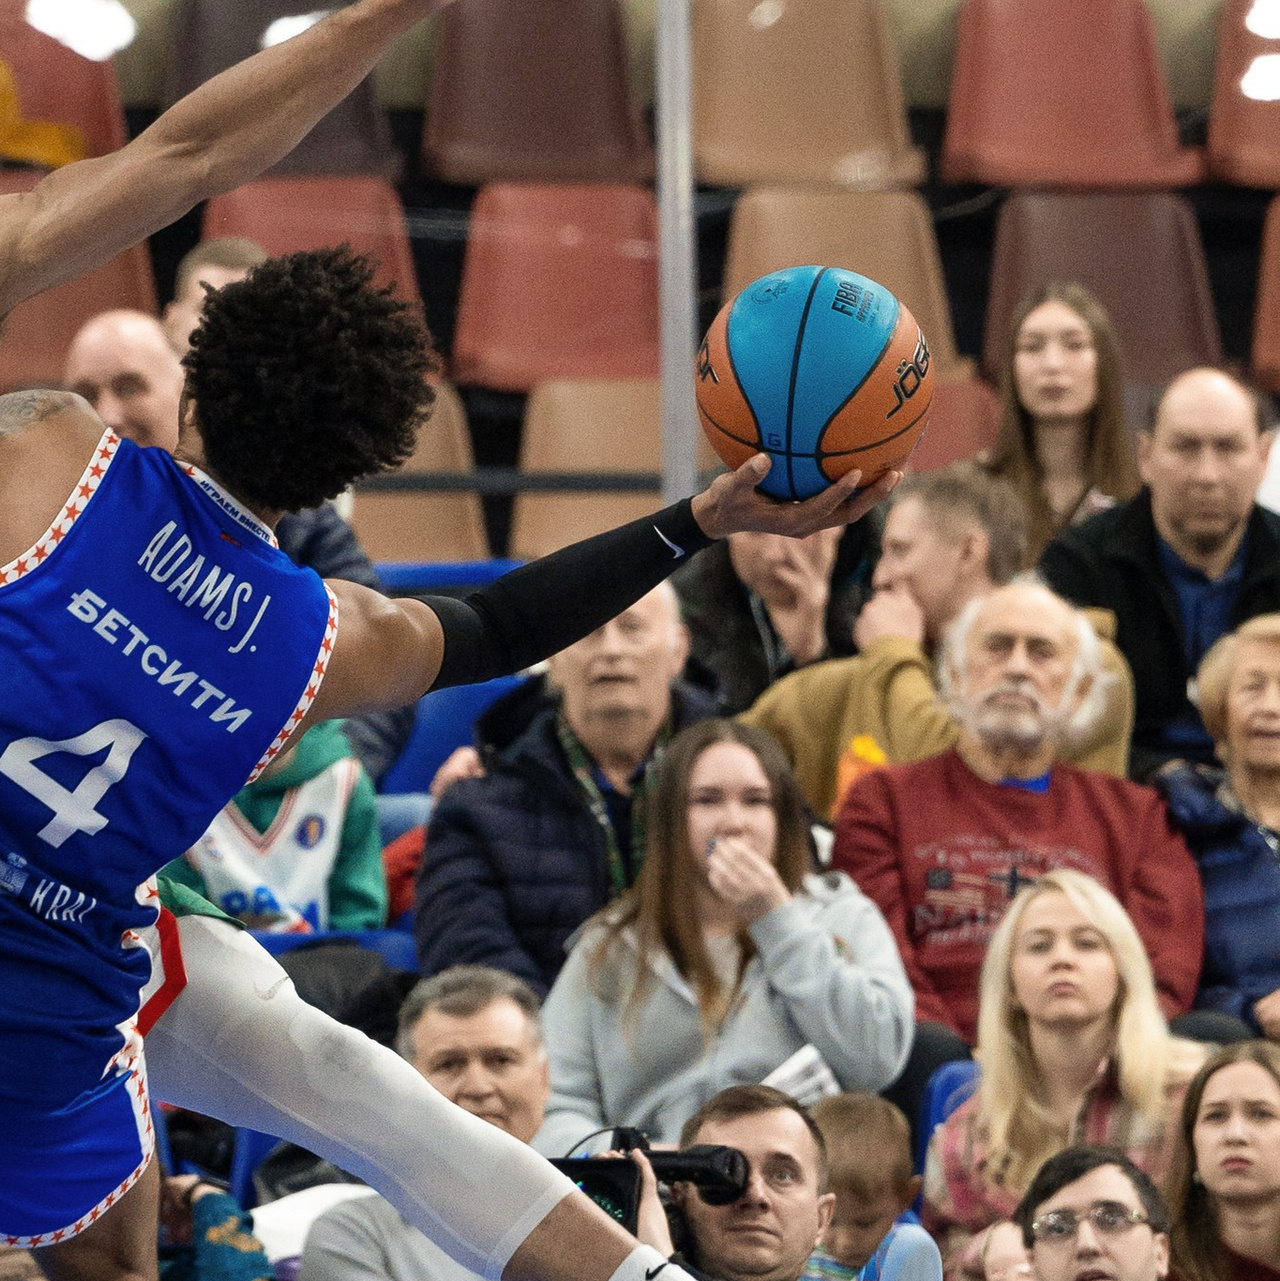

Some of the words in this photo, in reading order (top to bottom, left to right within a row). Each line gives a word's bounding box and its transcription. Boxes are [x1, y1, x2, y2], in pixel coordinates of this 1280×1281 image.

[831, 281, 863, 317] FIBA
[200, 480, 240, 518] ИГРАЕМ
[137, 520, 252, 631] ADAMS
[227, 594, 271, 654] J.
[66, 588, 252, 733] БЕТСИТИ
